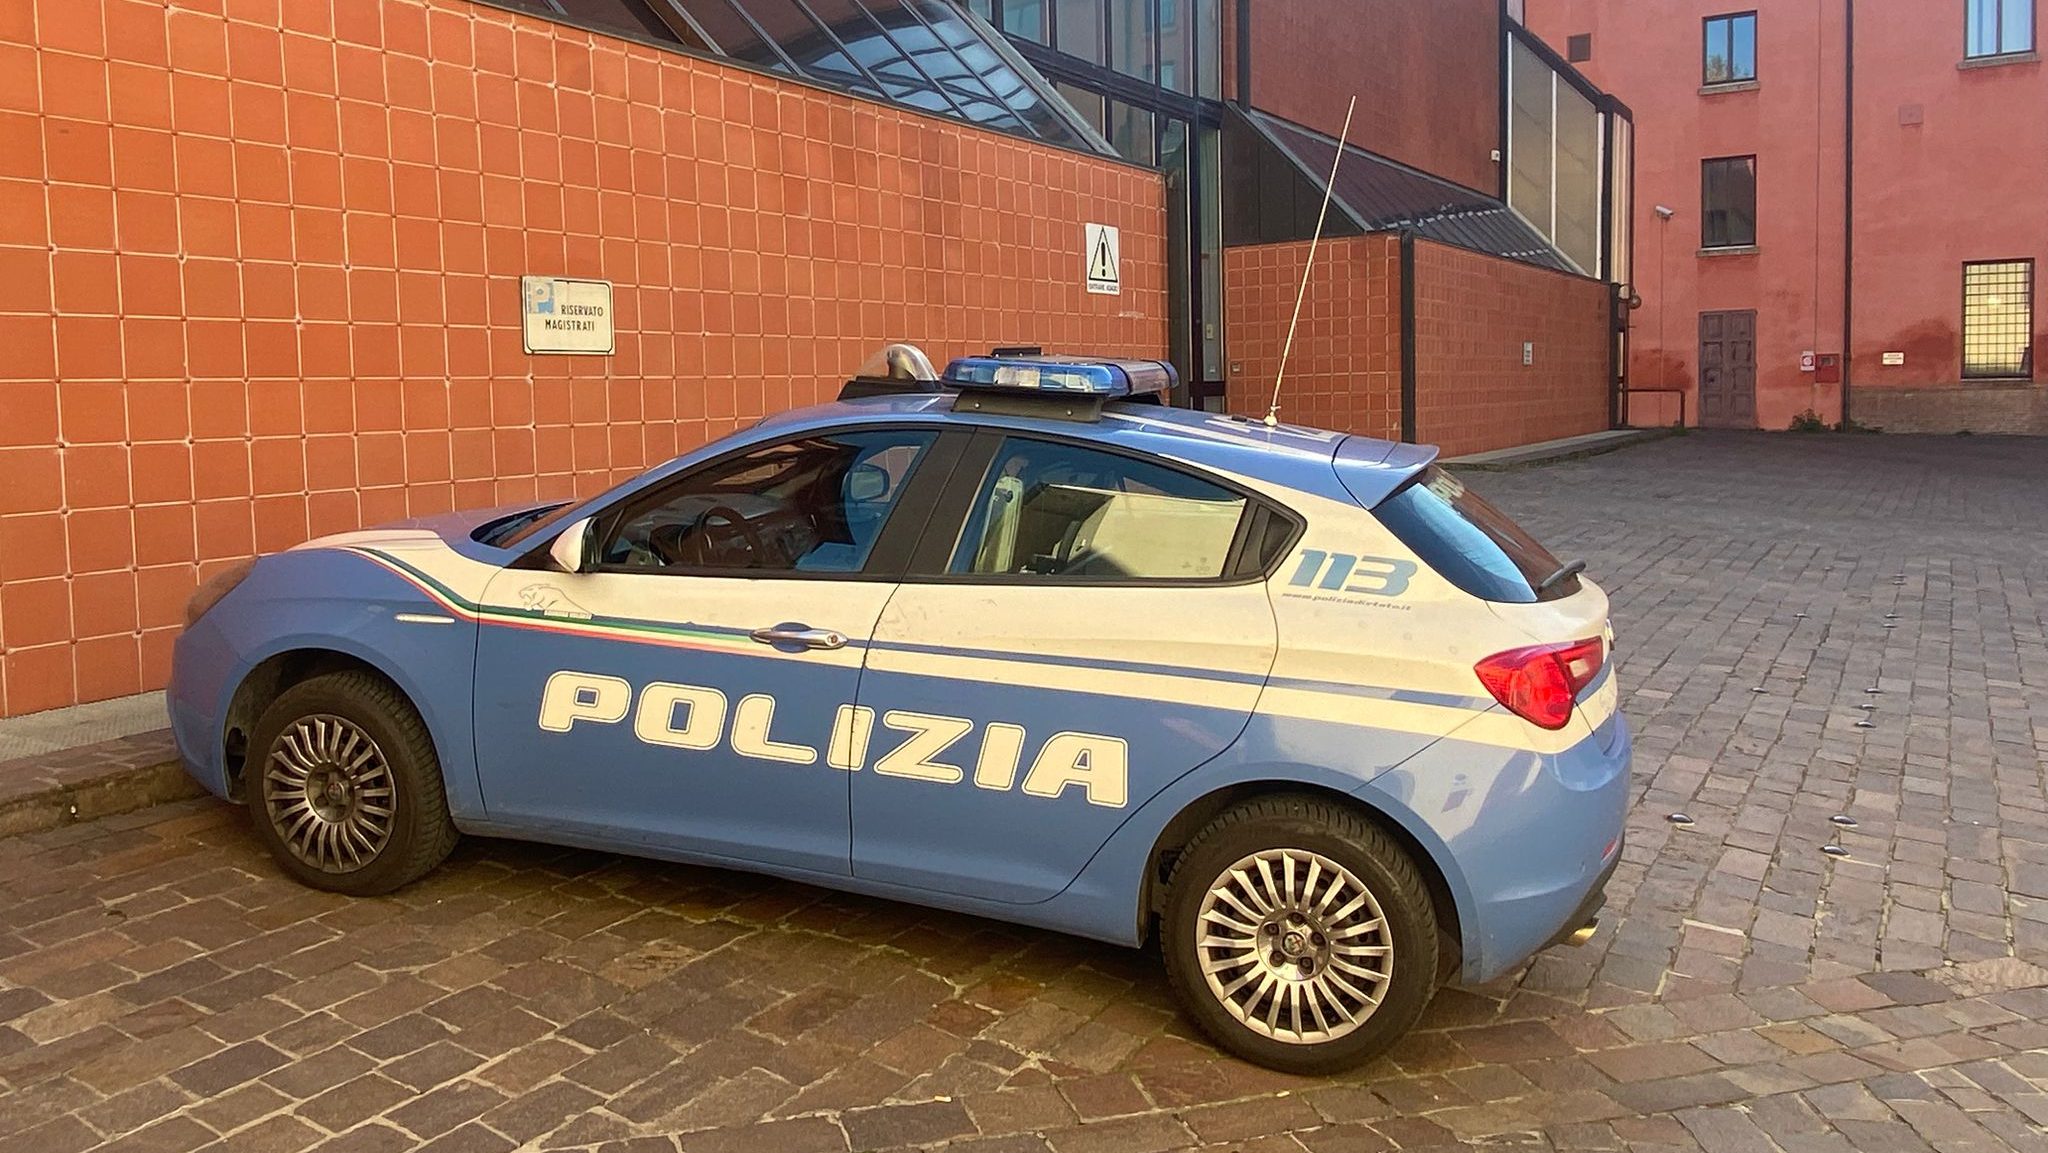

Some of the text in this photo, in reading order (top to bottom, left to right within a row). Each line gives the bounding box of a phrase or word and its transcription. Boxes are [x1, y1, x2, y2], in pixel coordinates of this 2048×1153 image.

[545, 319, 595, 332] MAGISTRATI
[561, 304, 604, 317] RISERVATO
[1288, 548, 1418, 597] 113
[538, 670, 1128, 808] POLIZIA
